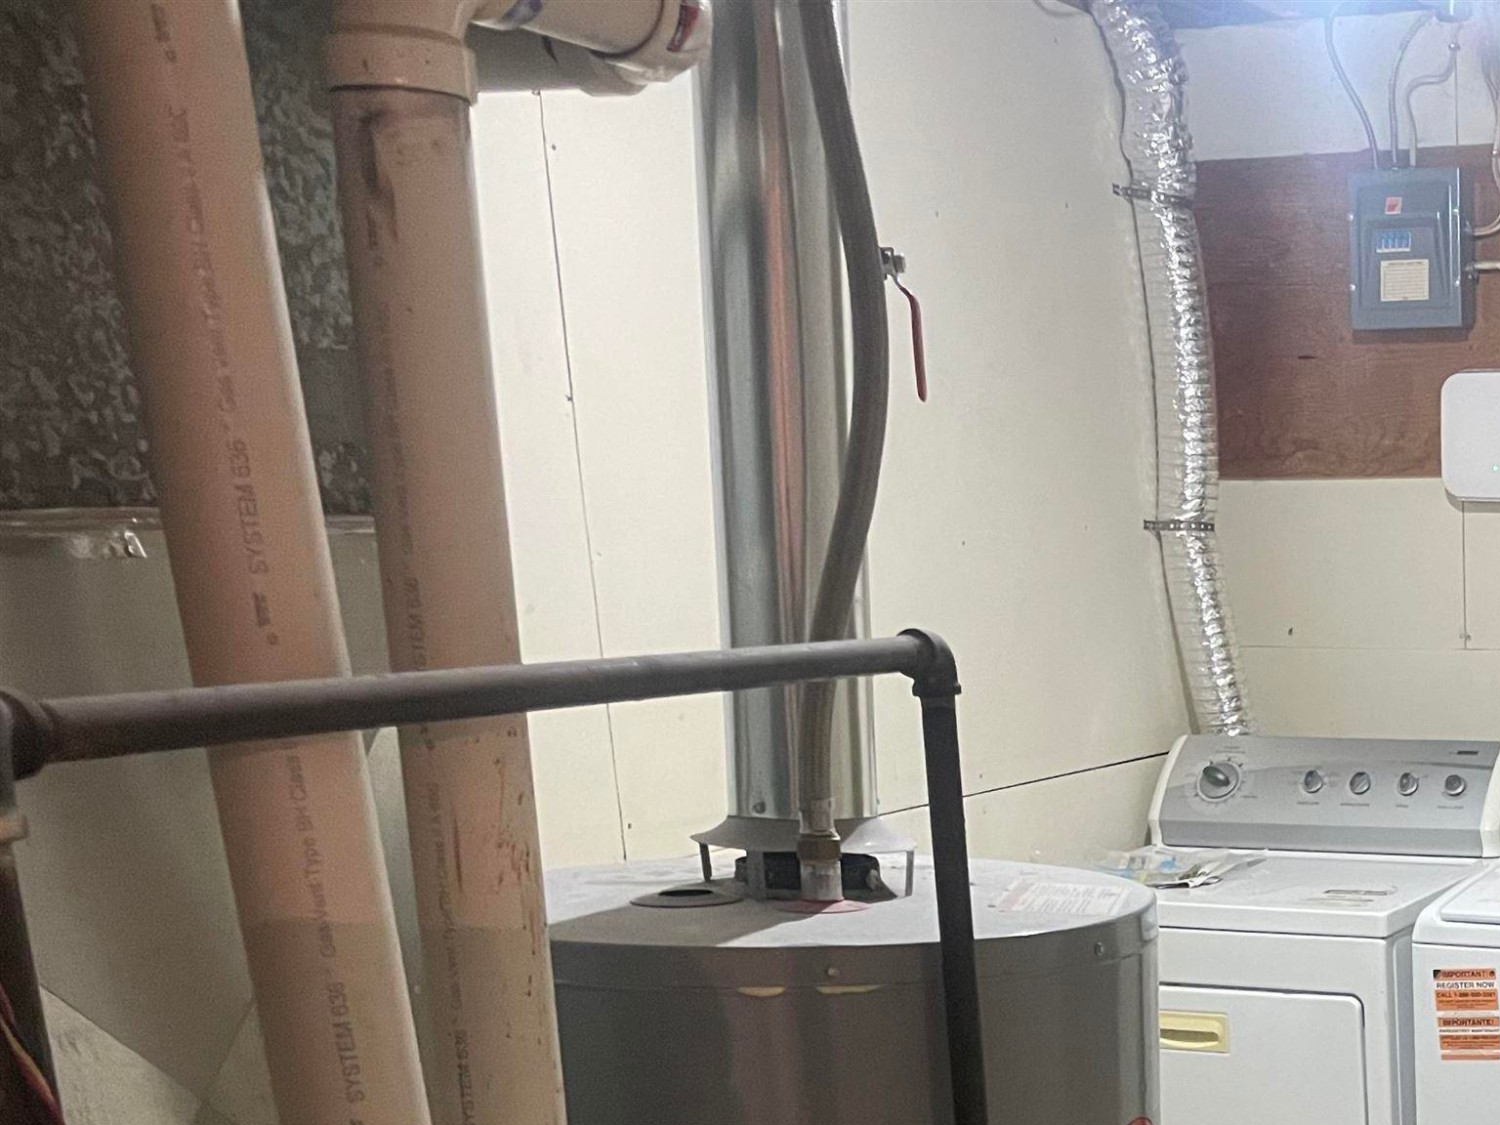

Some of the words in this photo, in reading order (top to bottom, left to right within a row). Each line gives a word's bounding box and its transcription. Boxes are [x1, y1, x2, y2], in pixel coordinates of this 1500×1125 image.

[227, 439, 251, 479] 636
[234, 483, 269, 575] SYSTEM
[408, 615, 427, 669] STEM
[285, 755, 307, 801] Class
[294, 806, 313, 832] BH
[299, 836, 323, 878] Type
[309, 883, 329, 919] Vent
[316, 923, 337, 958] Gas
[326, 982, 349, 1016] 636
[1436, 981, 1475, 989] REGISTER
[333, 1021, 365, 1103] SYSTEM
